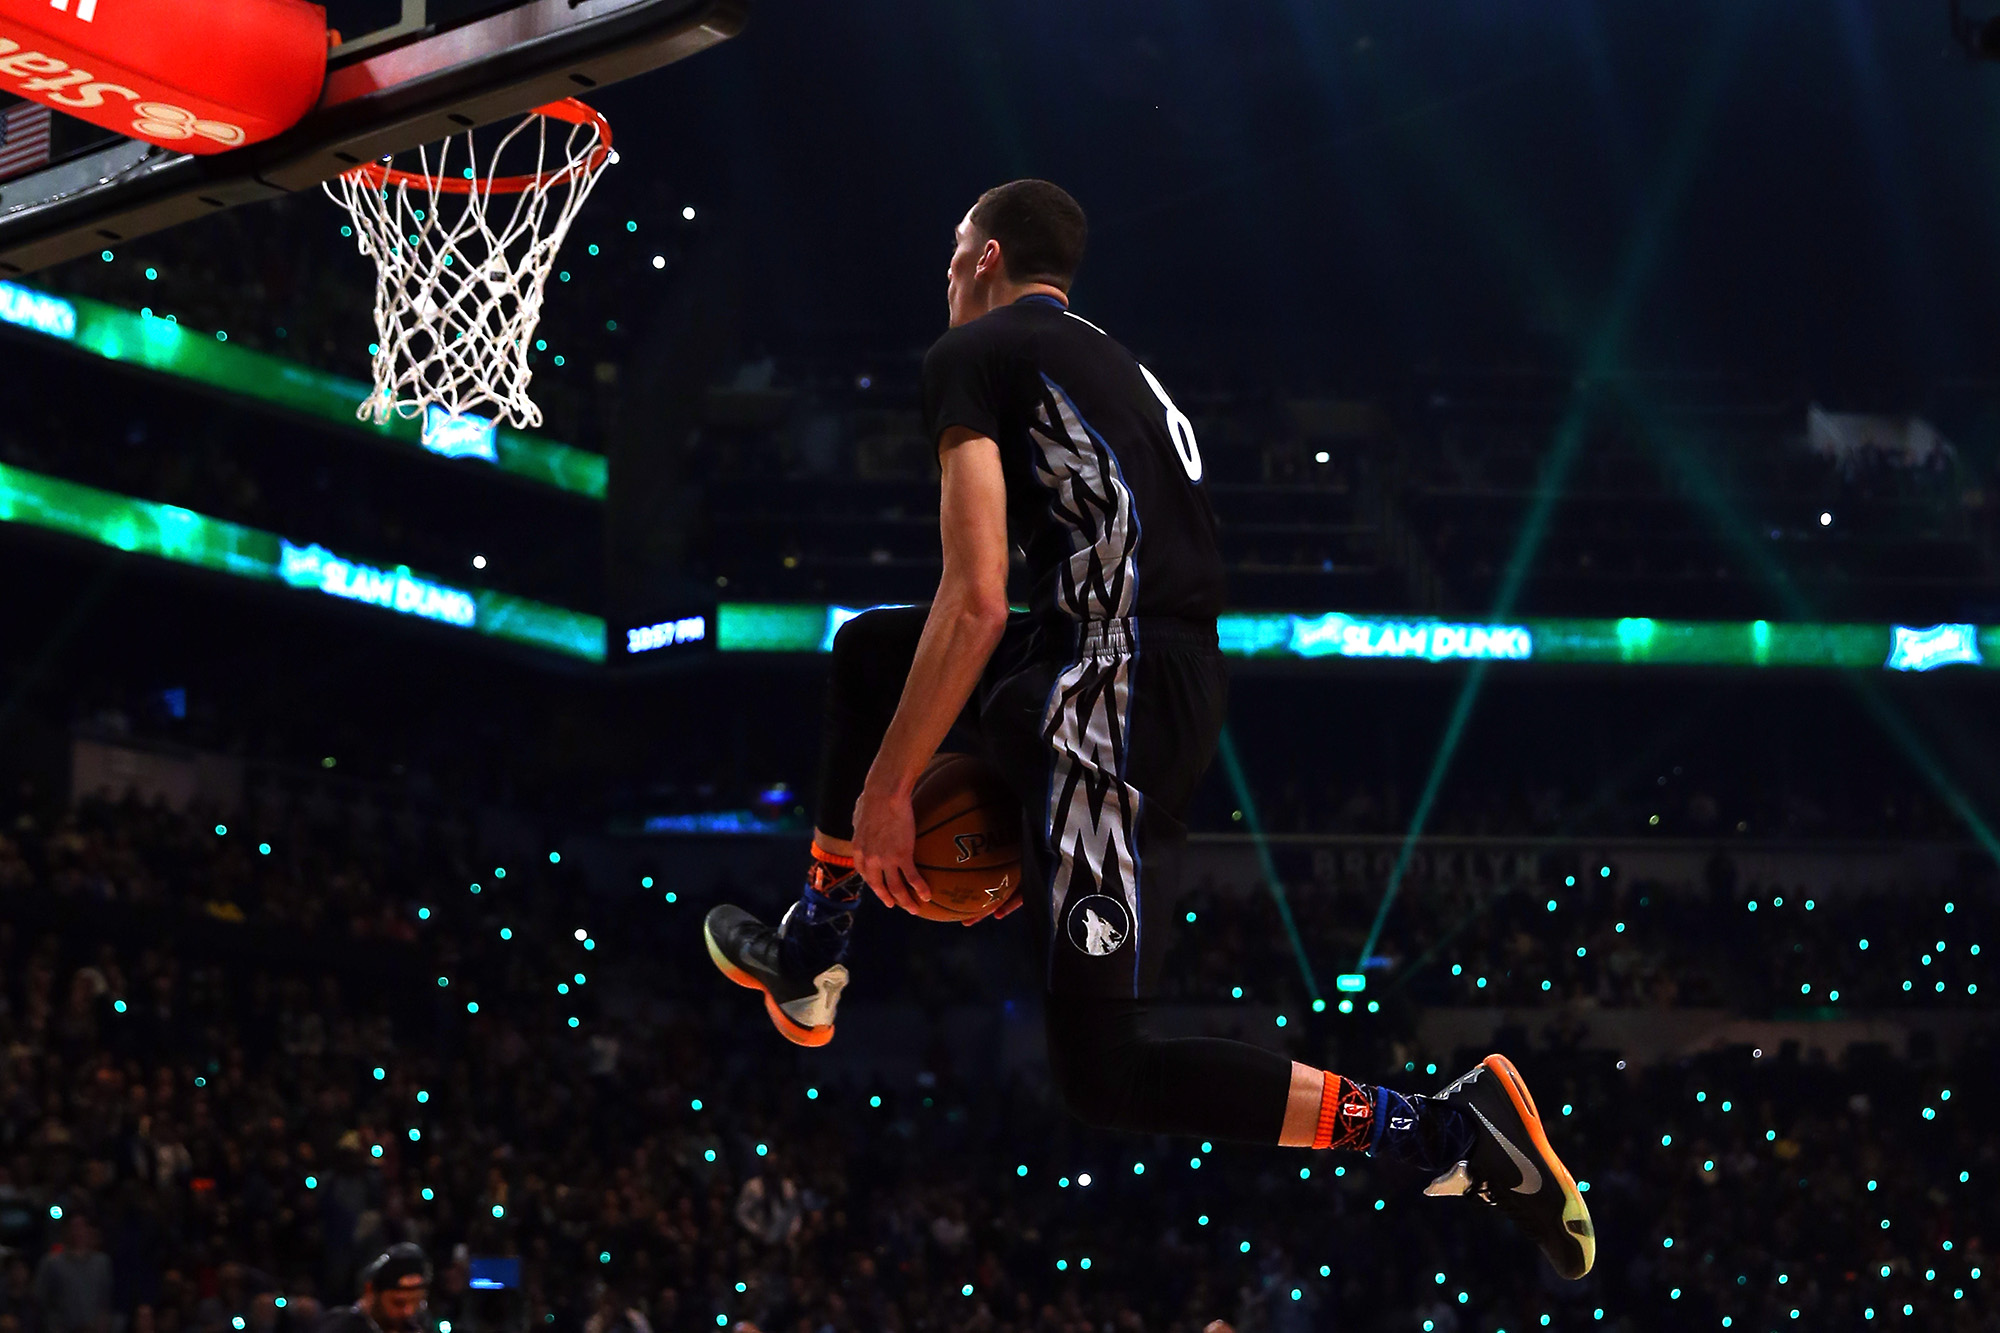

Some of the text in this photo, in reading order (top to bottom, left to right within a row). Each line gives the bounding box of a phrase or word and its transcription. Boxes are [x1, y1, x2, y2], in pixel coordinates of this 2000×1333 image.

[0, 37, 141, 108] Sta
[1137, 363, 1203, 483] 6
[320, 560, 396, 607] SLAM
[1340, 624, 1429, 658] SLAM
